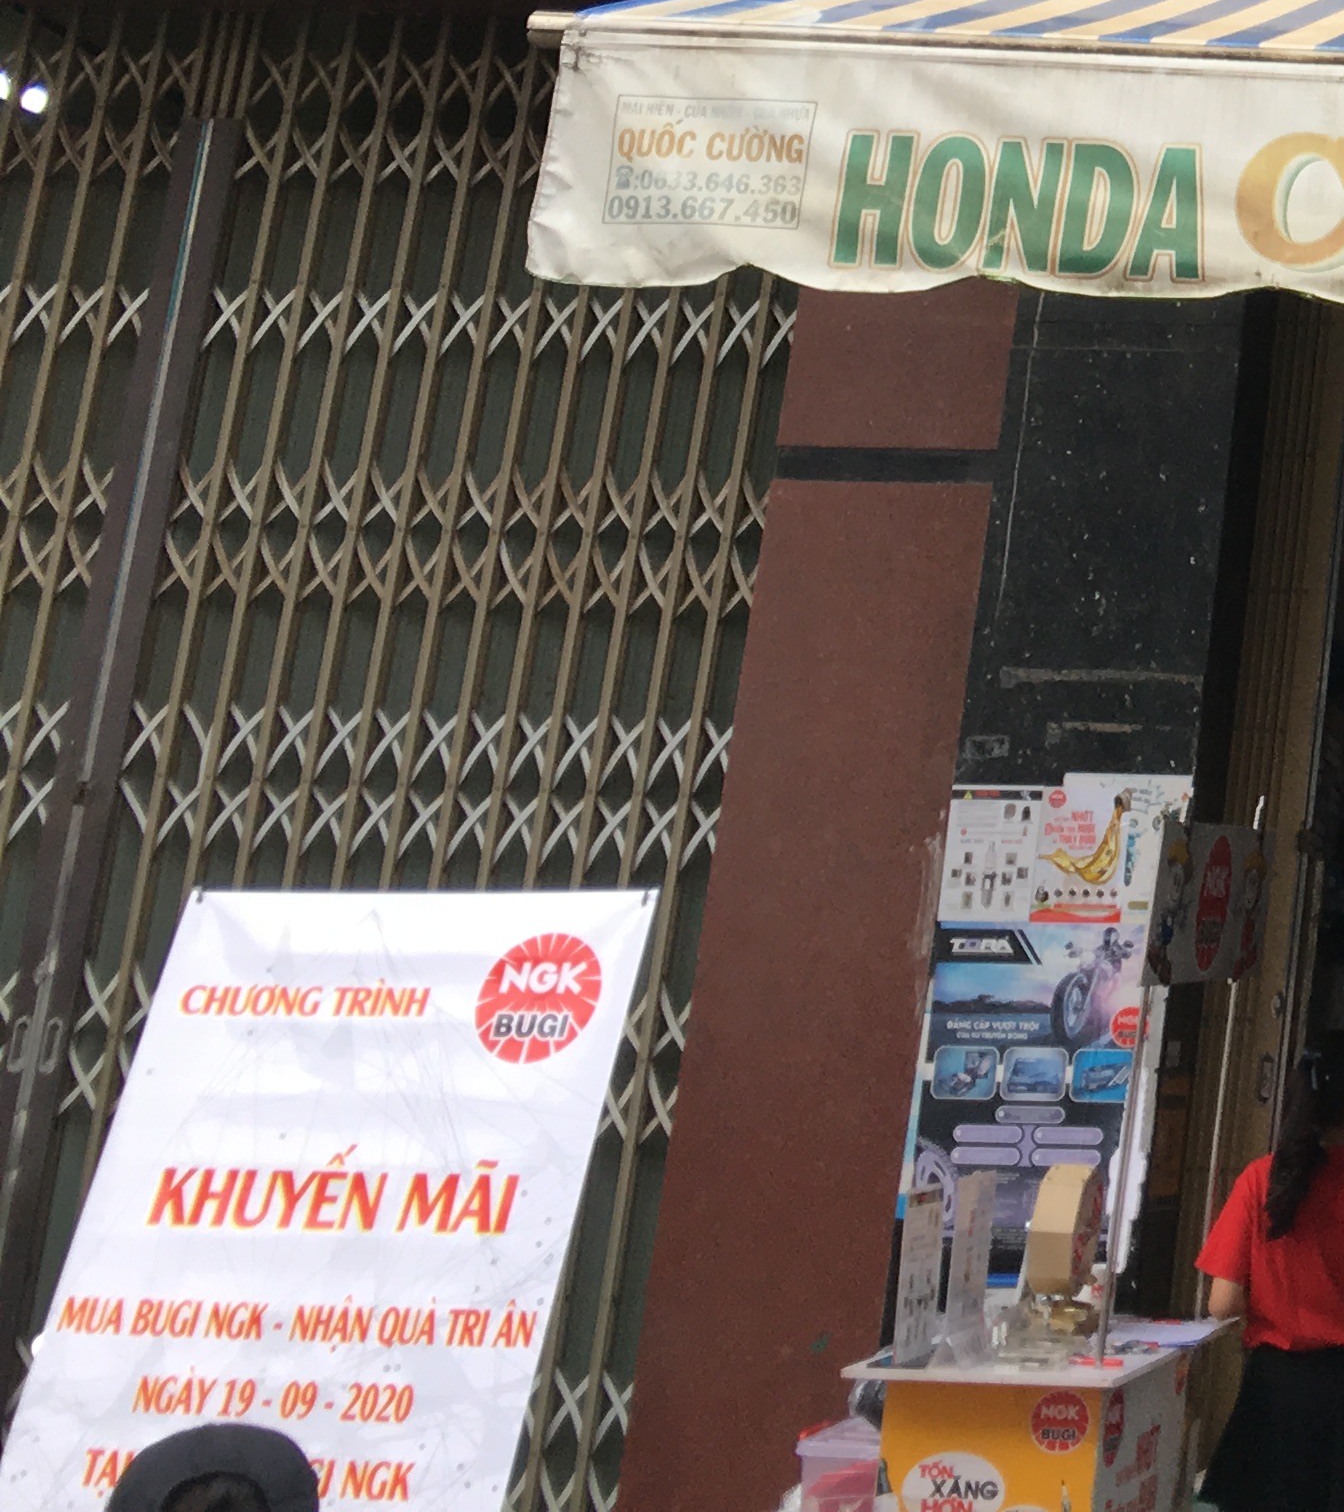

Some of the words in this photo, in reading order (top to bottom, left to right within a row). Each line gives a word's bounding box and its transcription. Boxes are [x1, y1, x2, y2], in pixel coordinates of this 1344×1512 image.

[617, 119, 698, 164] QUỐC
[705, 124, 805, 164] CƯỜNG
[828, 129, 1205, 282] HONDA
[179, 985, 322, 1017] CHƯƠNG
[330, 977, 431, 1018] TRÌNH
[499, 960, 588, 995] NGK
[492, 1012, 569, 1040] BUGI
[145, 1143, 390, 1234] KHUYẾN
[395, 1159, 520, 1234] MÃI
[56, 1296, 122, 1336] MUA
[129, 1299, 199, 1339] BUGI
[205, 1303, 268, 1340] NGK
[288, 1294, 374, 1352] NHẬN
[446, 1308, 491, 1348] TRI
[491, 1299, 540, 1349] ÂN
[217, 1378, 257, 1418] 19
[279, 1381, 319, 1420] 09
[340, 1383, 414, 1425] 2020
[341, 1460, 414, 1502] NGK
[929, 1475, 999, 1501] XĂNG
